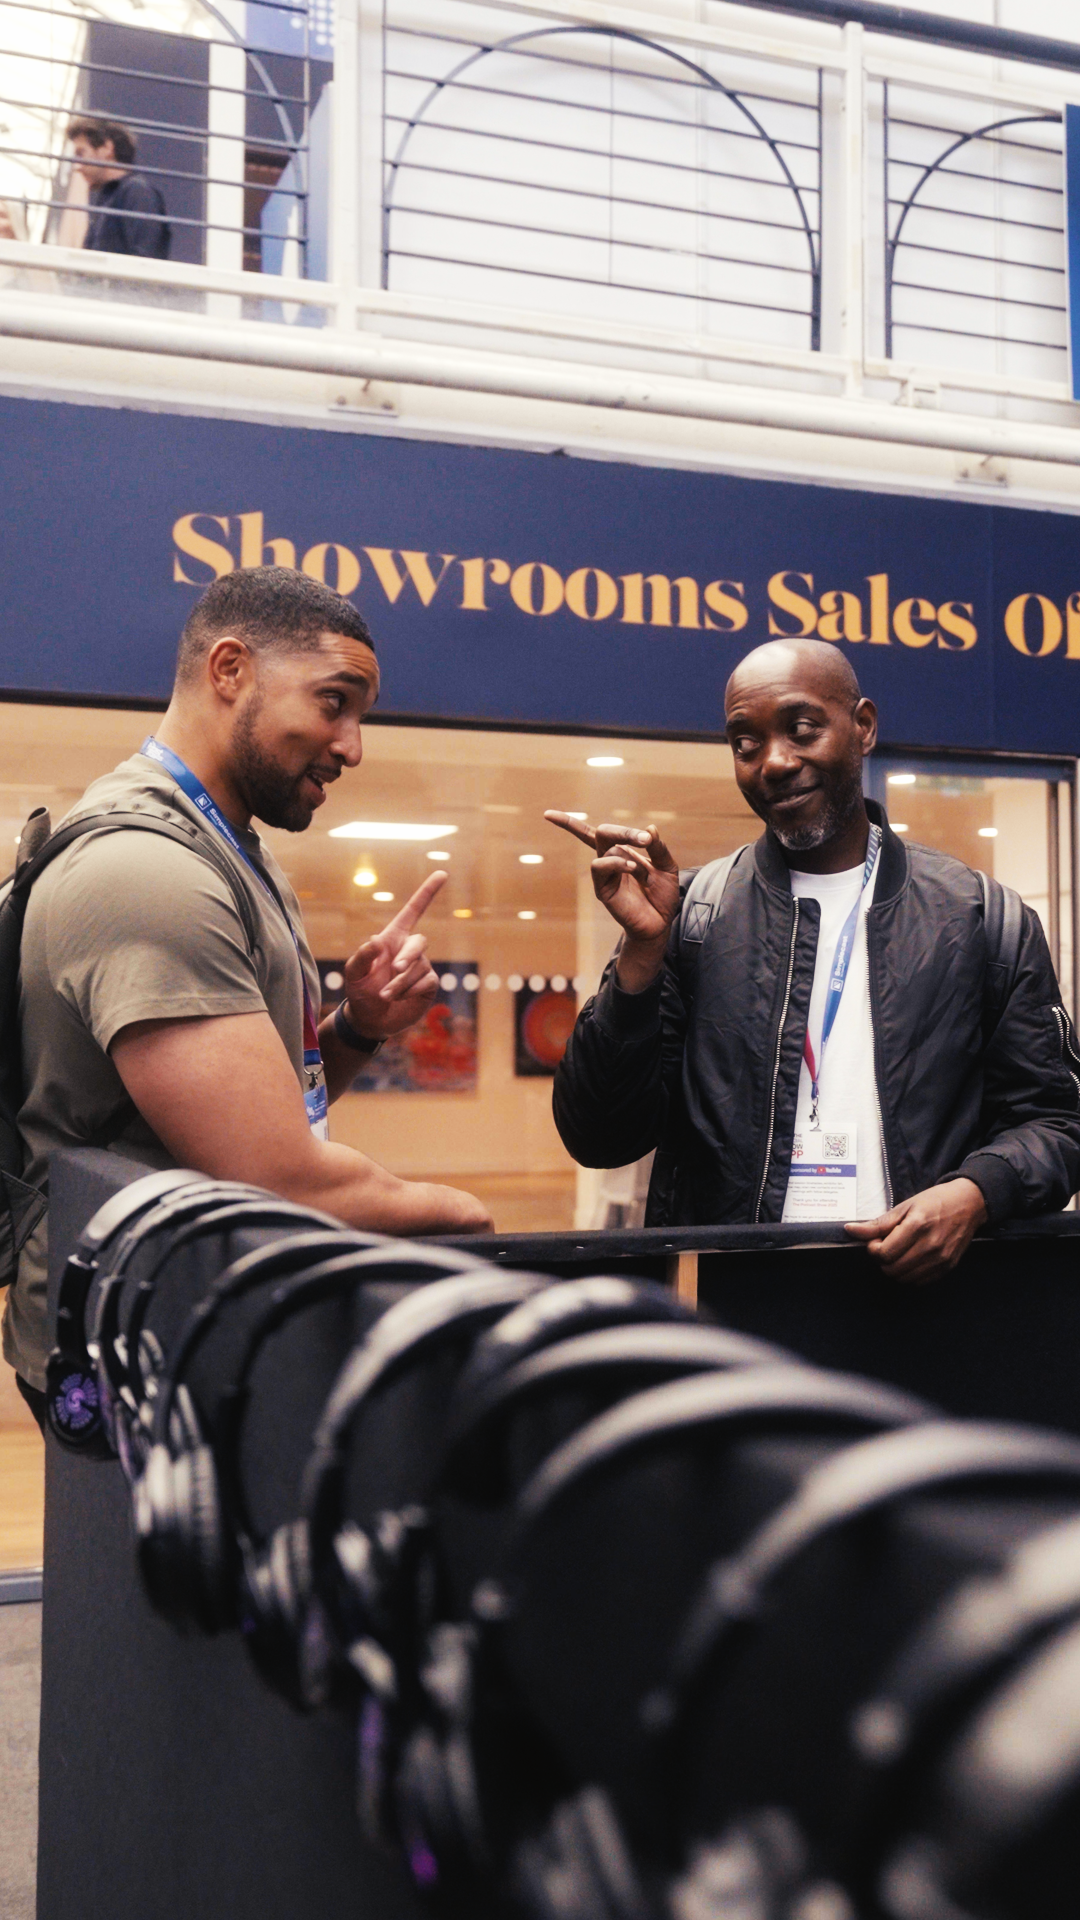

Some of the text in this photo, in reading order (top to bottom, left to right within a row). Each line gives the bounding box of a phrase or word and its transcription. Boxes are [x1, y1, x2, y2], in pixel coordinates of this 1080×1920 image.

[172, 510, 750, 632] Showrooms
[767, 570, 978, 651] Sales
[210, 807, 240, 849] Simplecast
